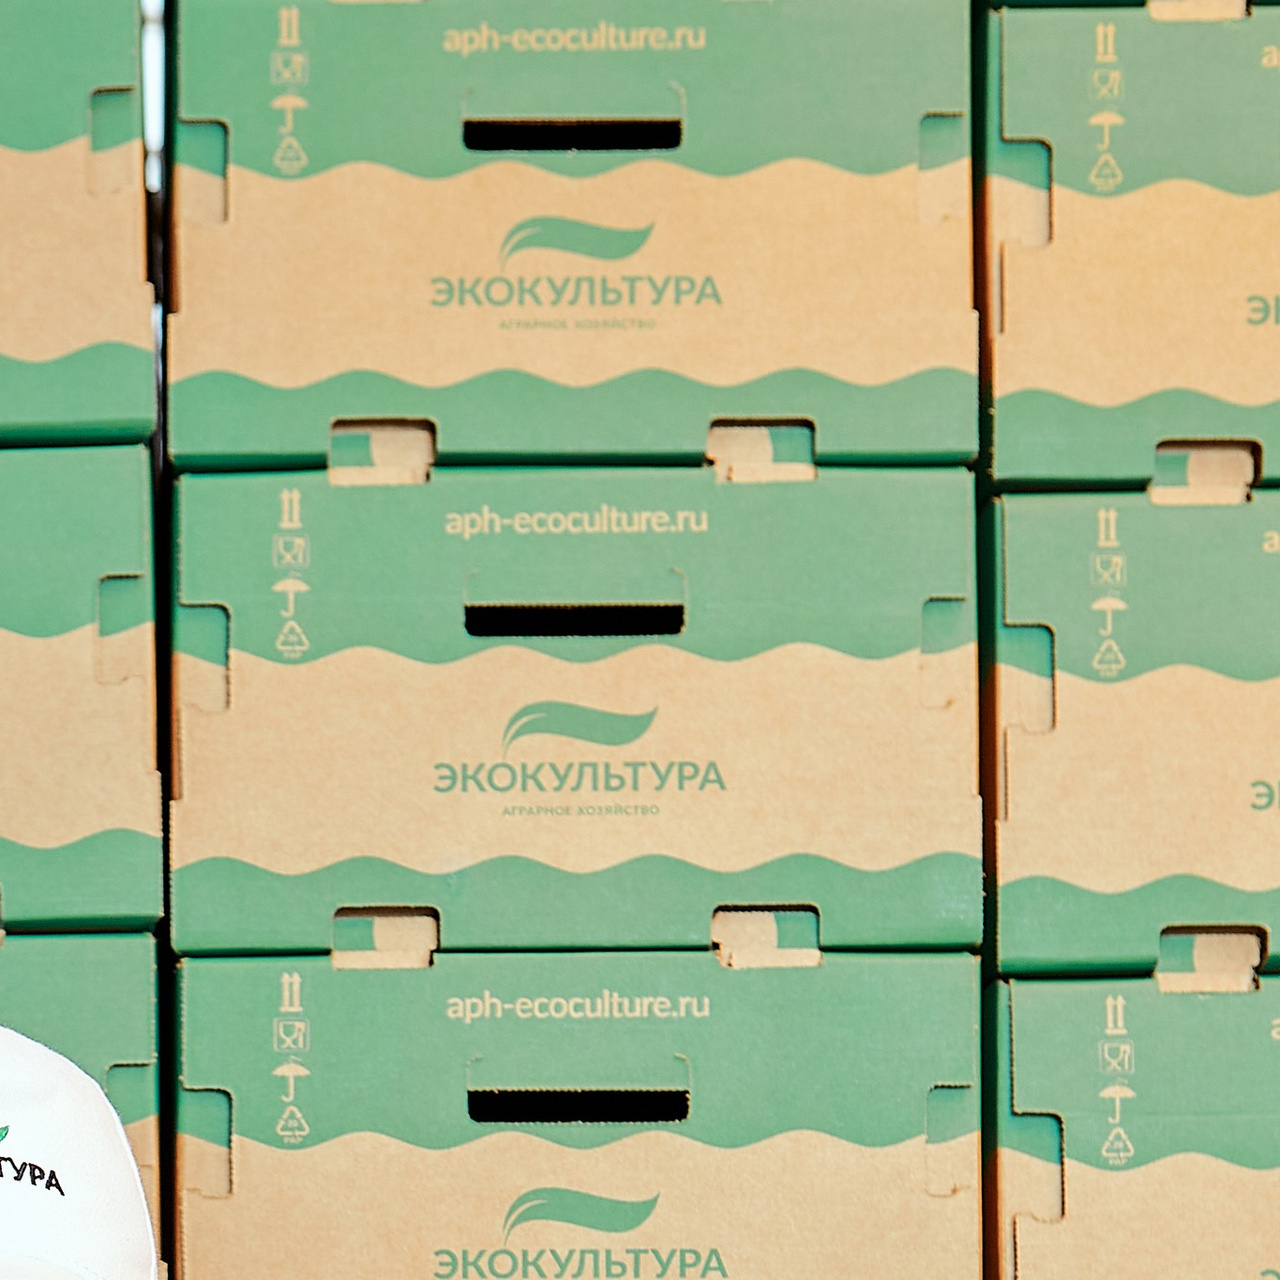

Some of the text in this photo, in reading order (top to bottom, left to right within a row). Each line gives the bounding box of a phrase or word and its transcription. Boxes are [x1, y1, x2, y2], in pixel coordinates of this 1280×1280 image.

[444, 22, 705, 55] aph-ecoculture.ru
[431, 276, 723, 308] ЭКОКУЛЬТУРА
[446, 504, 708, 539] aph-ecoculture.ru
[433, 762, 726, 794] ЭКОКУЛЬТУРА
[500, 806, 661, 817] АГРАРНОЕ ХОЗЯЙСТВО
[447, 990, 710, 1024] aph-ecoculture.ru
[435, 1249, 728, 1280] ЭКОКУЛЬТУРА
